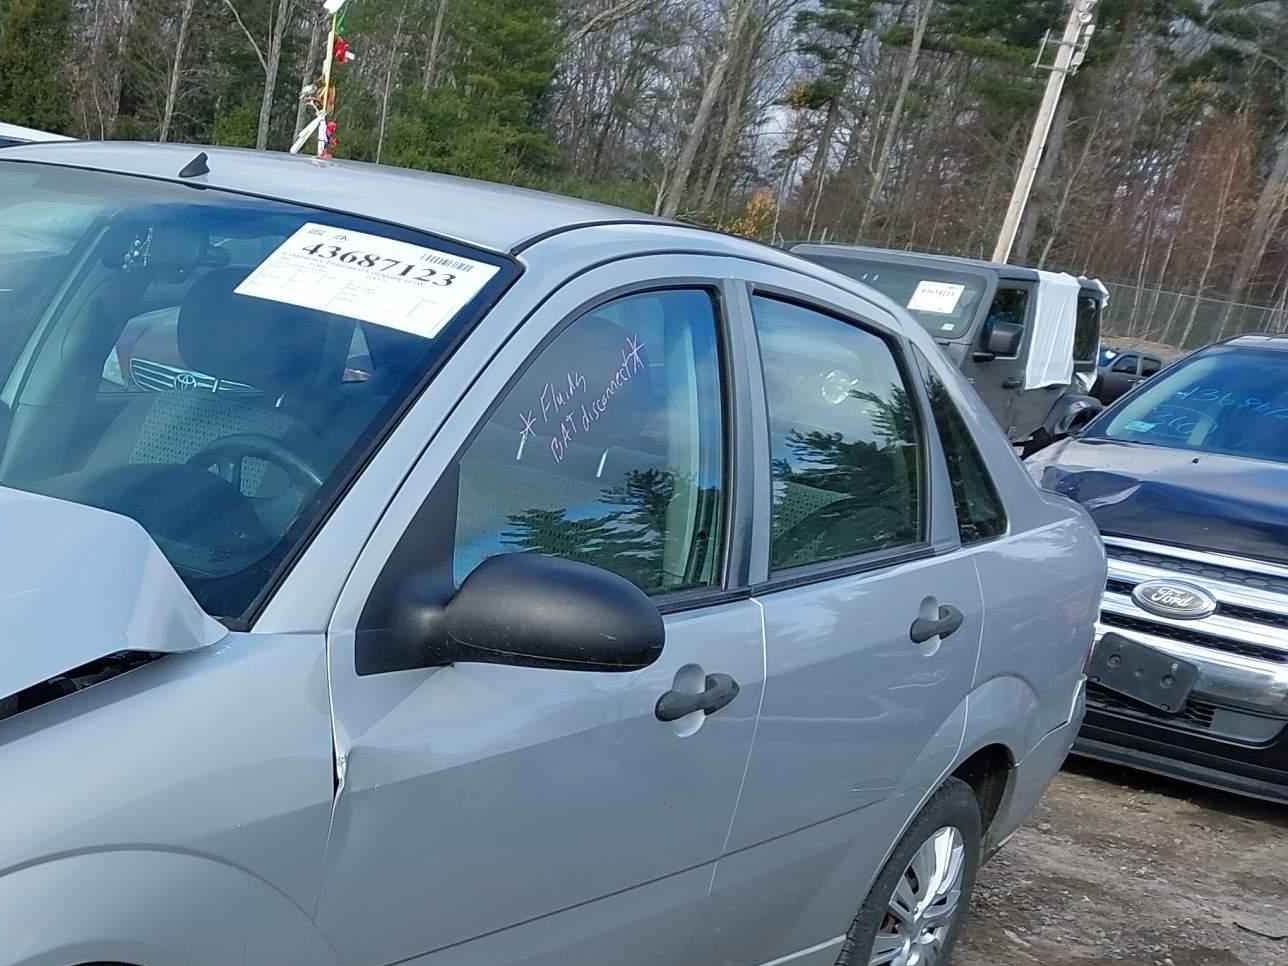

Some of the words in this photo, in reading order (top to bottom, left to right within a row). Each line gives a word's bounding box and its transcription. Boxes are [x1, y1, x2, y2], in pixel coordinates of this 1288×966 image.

[302, 242, 457, 287] 43687123
[550, 411, 577, 463] BAT
[1151, 587, 1193, 608] Ford
